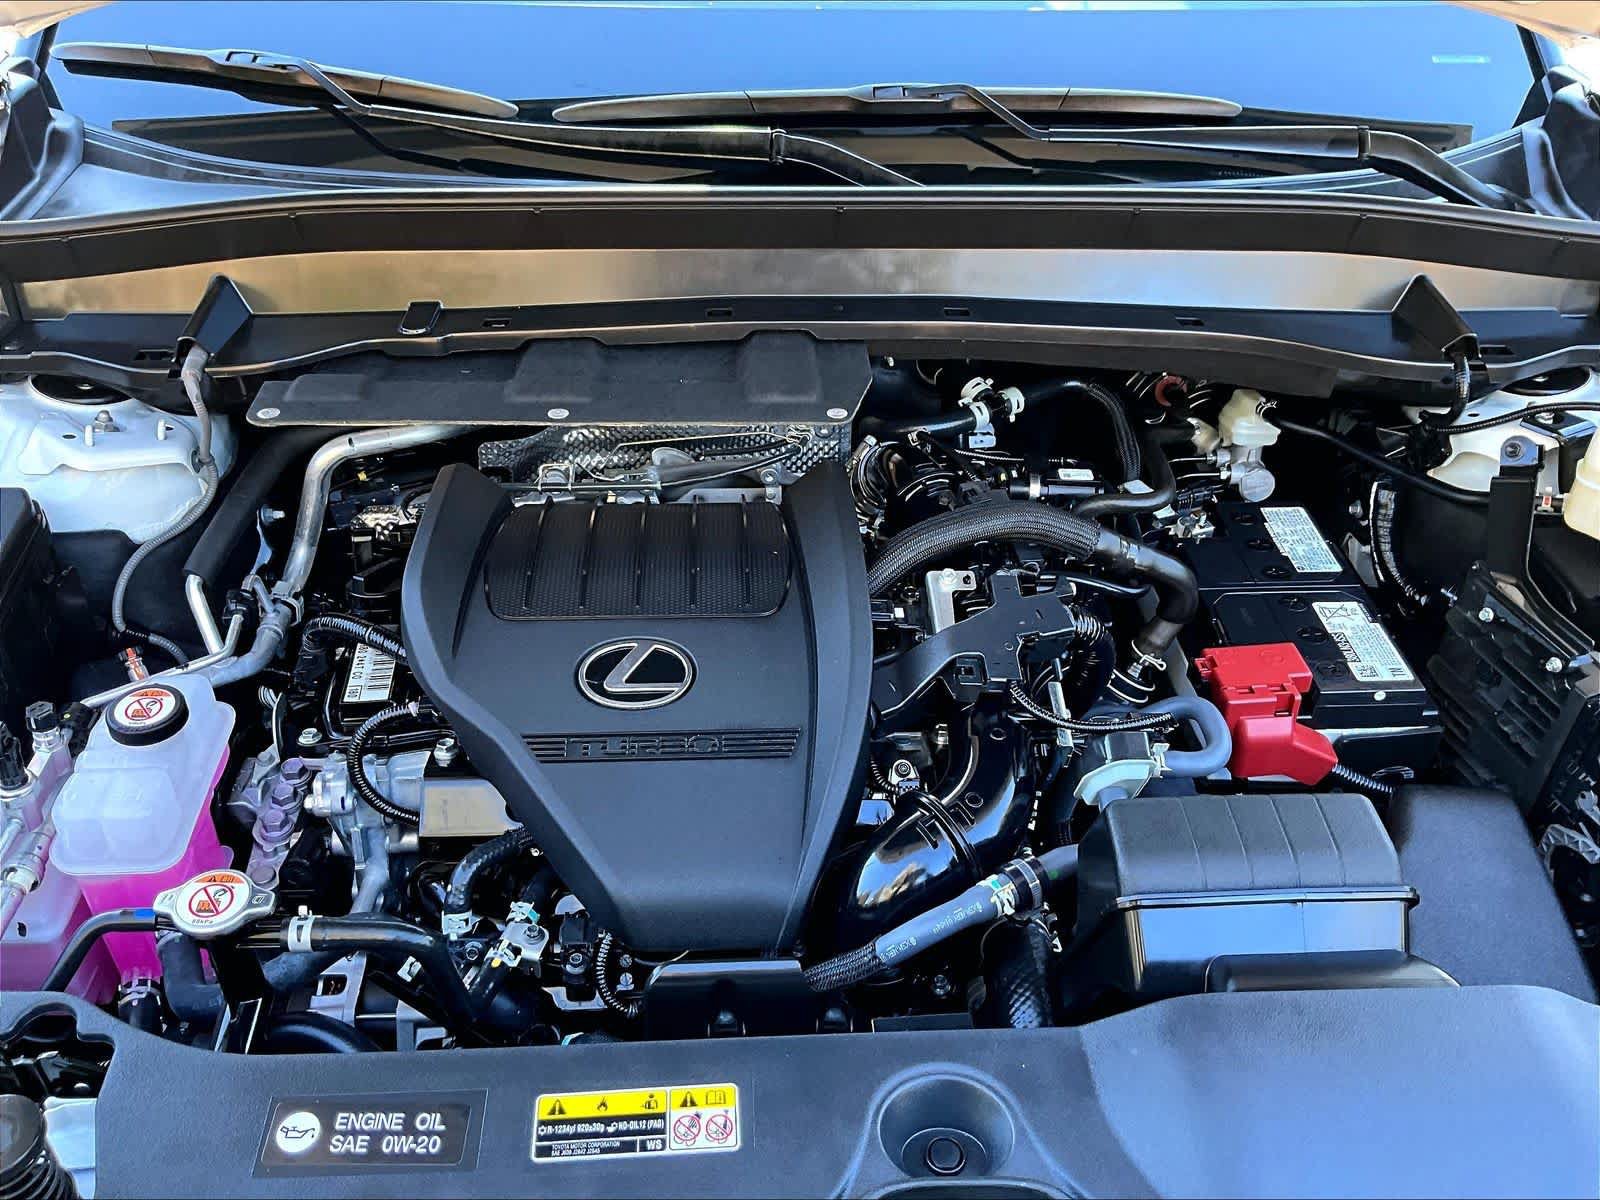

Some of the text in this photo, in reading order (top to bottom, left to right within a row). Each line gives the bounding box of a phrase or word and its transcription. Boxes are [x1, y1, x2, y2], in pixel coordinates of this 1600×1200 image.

[335, 1112, 446, 1131] ENGINE OIL
[329, 1135, 441, 1153] SAE 0W-20
[588, 1140, 620, 1148] CORPORATION
[646, 1139, 662, 1150] WS
